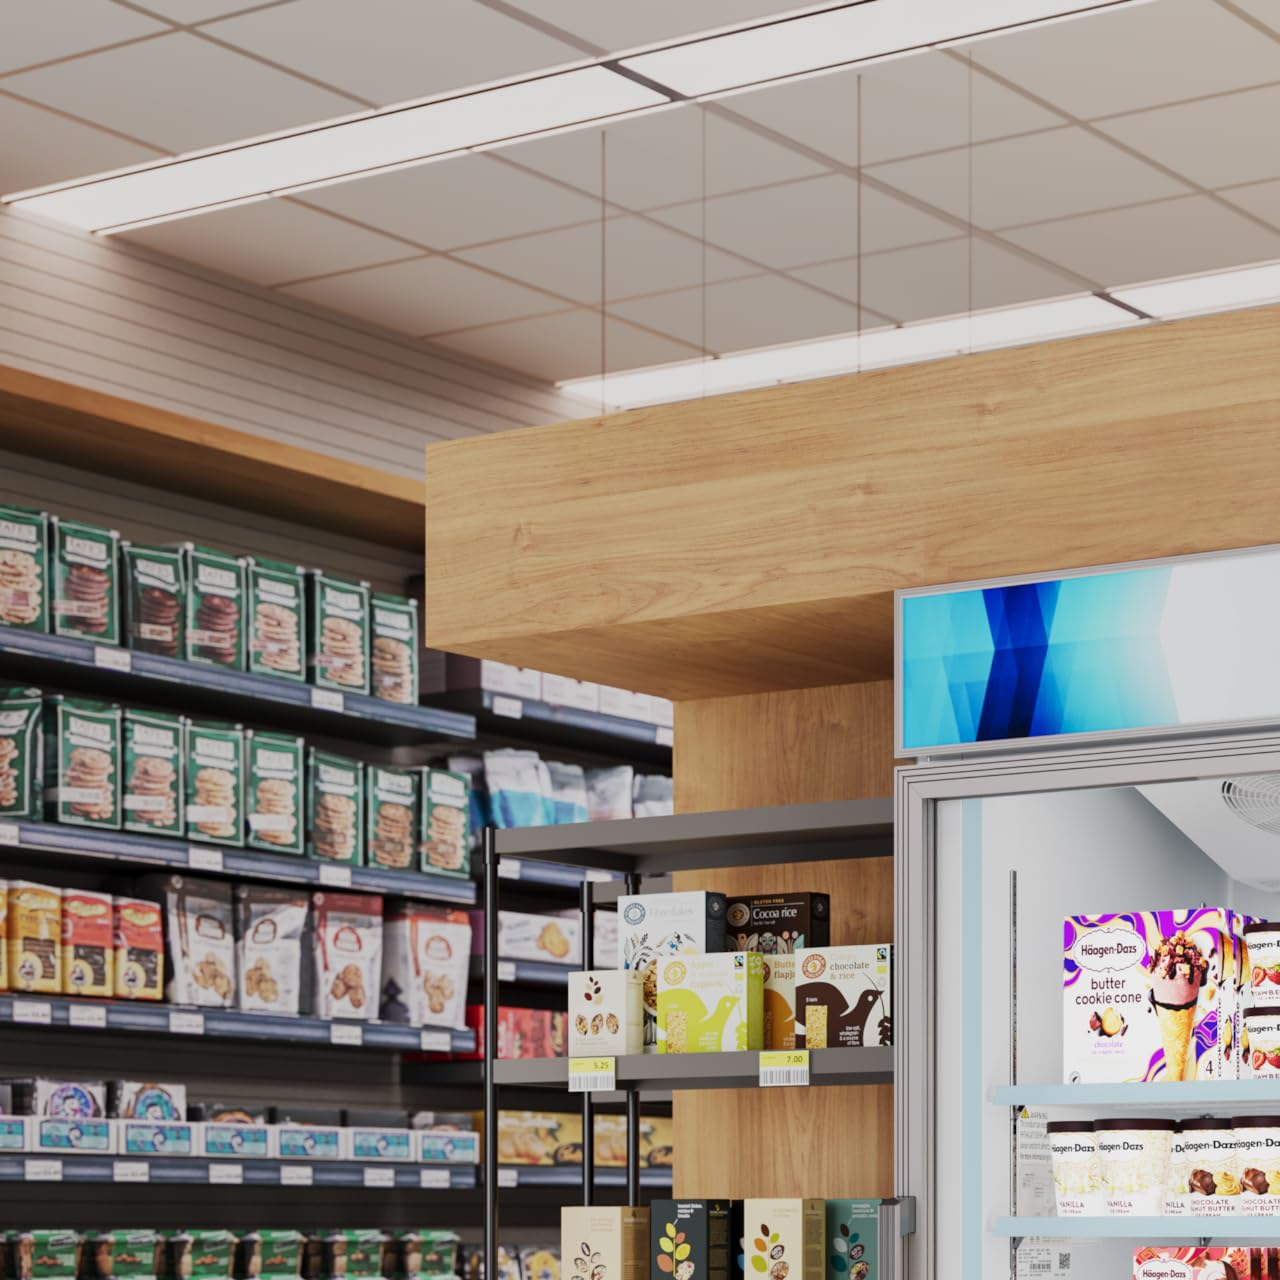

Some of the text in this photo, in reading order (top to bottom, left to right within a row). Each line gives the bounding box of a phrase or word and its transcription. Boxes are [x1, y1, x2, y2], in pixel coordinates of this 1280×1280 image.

[752, 907, 798, 920] Cocoa rice
[830, 961, 870, 970] chocolate
[838, 972, 855, 980] rice
[1091, 978, 1126, 990] butter
[1075, 992, 1142, 1005] cookie cone
[1206, 1061, 1214, 1074] 4
[1052, 1144, 1096, 1154] äagen-Dazs
[1100, 1142, 1144, 1152] äagen-Dazs
